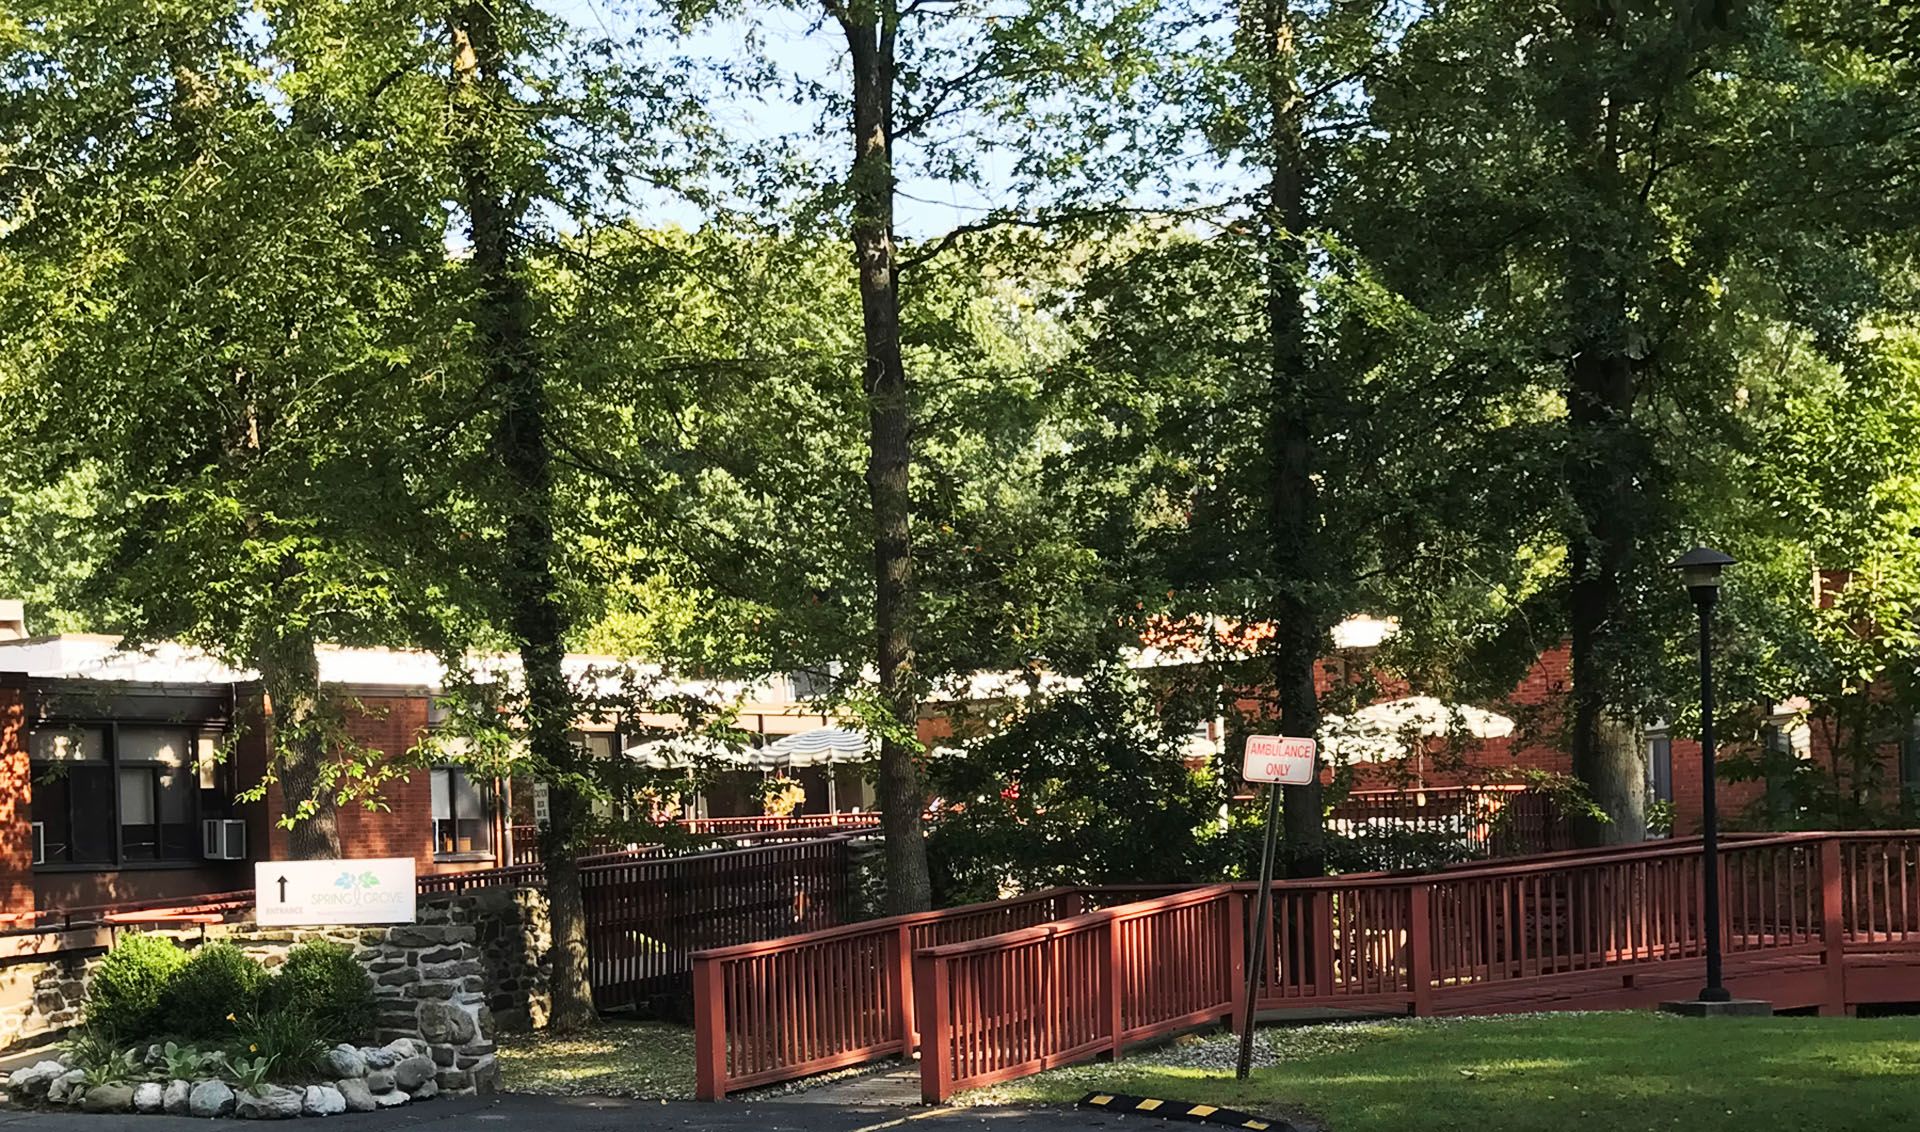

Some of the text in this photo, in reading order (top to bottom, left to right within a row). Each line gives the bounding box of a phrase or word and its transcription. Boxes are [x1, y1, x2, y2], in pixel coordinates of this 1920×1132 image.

[1250, 743, 1311, 758] AMBULANCE
[1266, 763, 1291, 776] ONLY
[311, 892, 405, 905] SPRING GROVE
[266, 906, 304, 915] ENTRANCE
